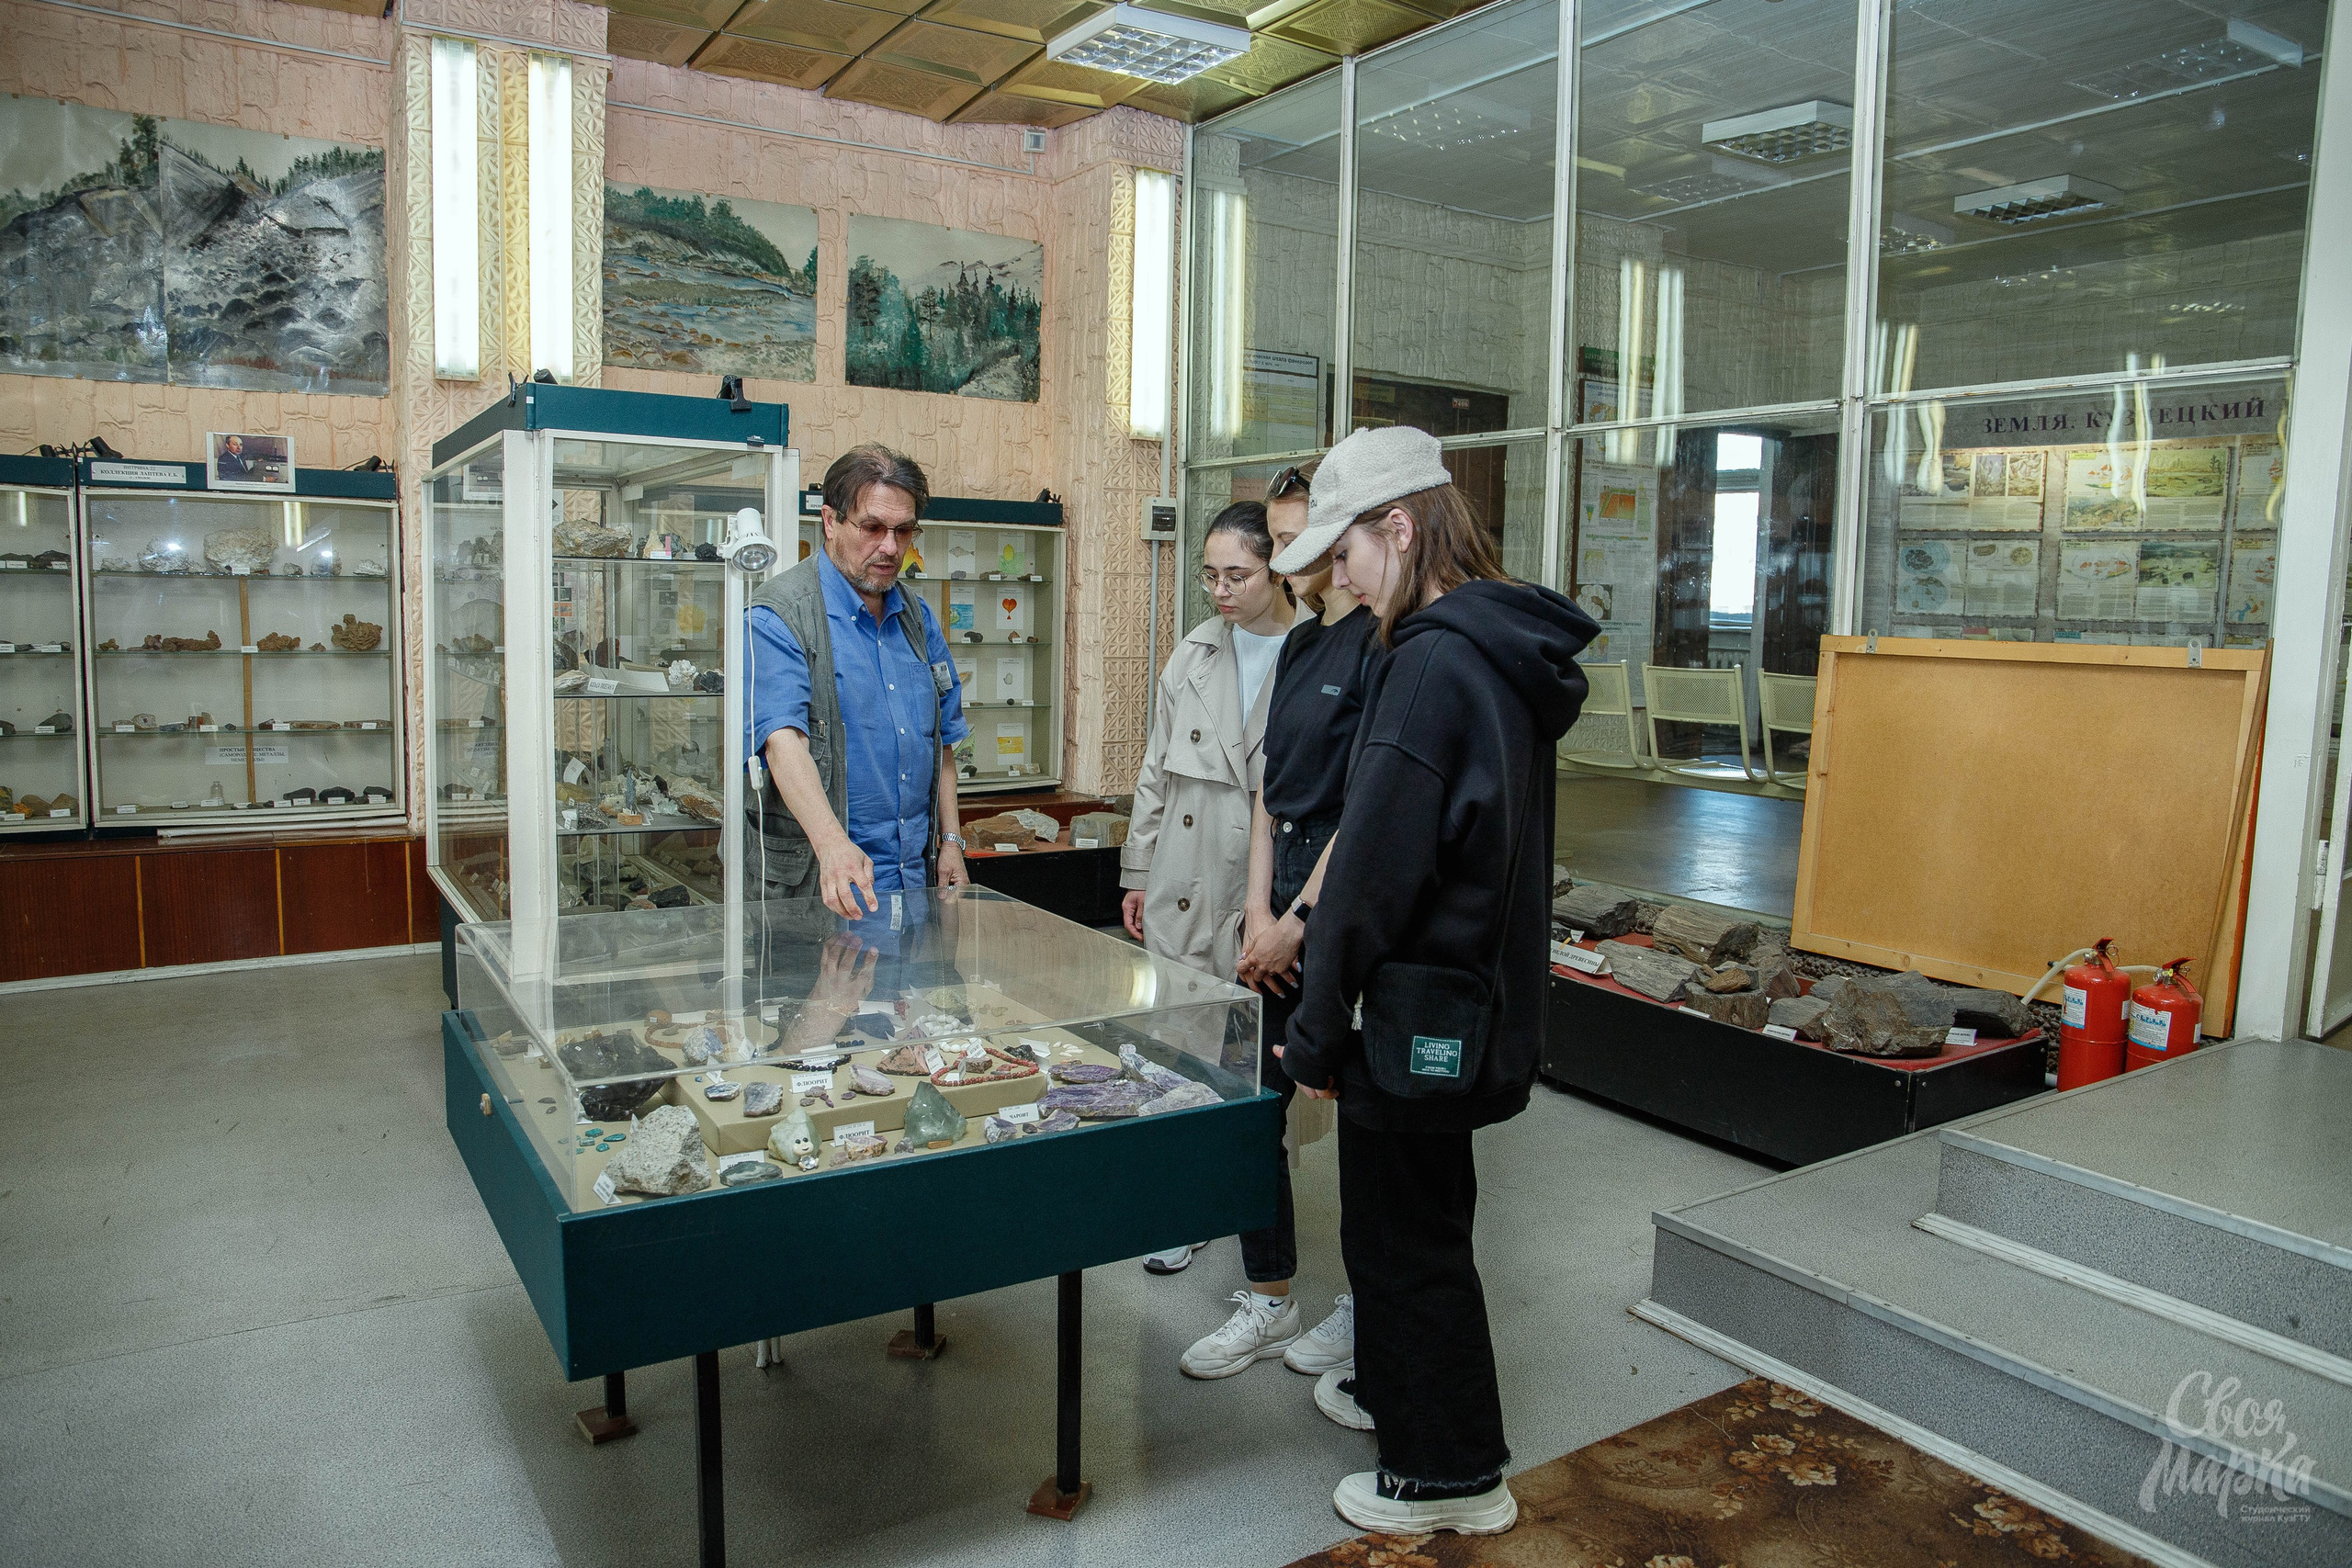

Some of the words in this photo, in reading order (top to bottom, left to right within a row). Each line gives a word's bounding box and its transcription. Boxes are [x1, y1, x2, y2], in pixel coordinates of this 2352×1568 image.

[2086, 397, 2266, 430] КУЗЕЦКИЙ
[1424, 1041, 1451, 1051] LIVING
[1424, 1054, 1449, 1063] SHARE
[796, 1077, 829, 1088] ФЛЮОРИТ
[1009, 1111, 1030, 1120] ЧАРОИТ
[838, 1129, 871, 1140] ФЛЮОРИТ
